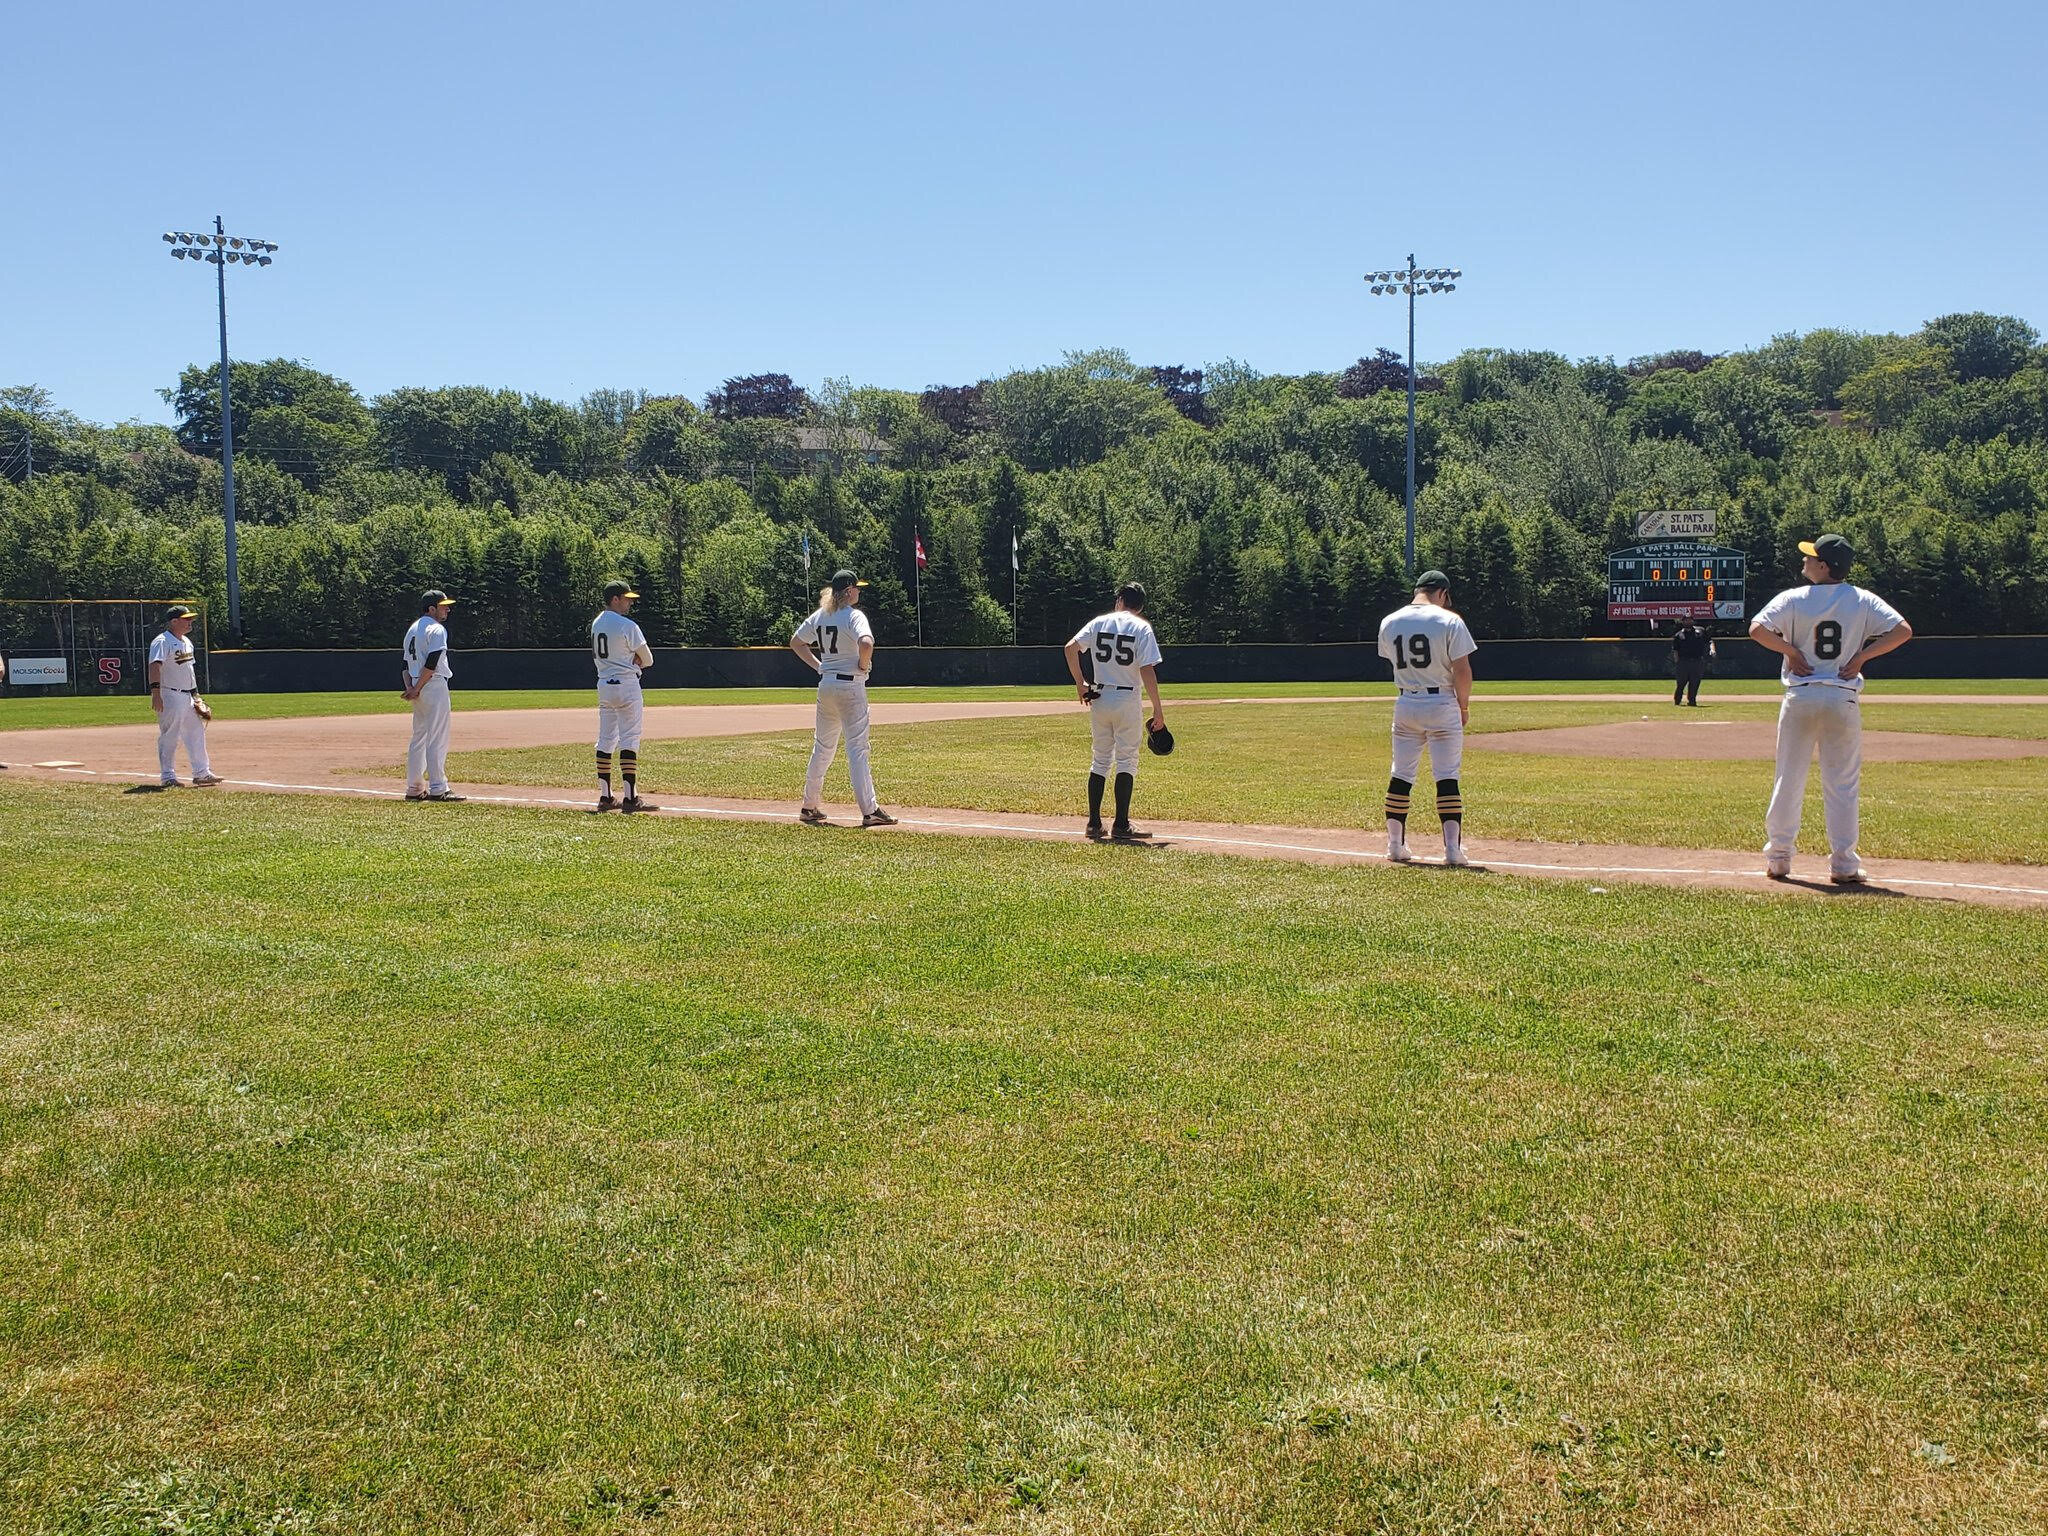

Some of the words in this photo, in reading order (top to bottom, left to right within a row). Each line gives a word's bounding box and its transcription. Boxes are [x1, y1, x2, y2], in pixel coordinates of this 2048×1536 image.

[1670, 514, 1681, 523] ST.
[1683, 513, 1704, 523] PAT'S
[1640, 513, 1664, 536] CANADIAN
[1670, 524, 1691, 533] BALL
[1692, 523, 1714, 533] PARK
[1648, 544, 1671, 552] PAT'S
[1696, 544, 1718, 553] PARK
[1650, 560, 1663, 569] BALL
[1673, 560, 1694, 569] STRIKE
[1701, 560, 1713, 568] OUT
[1652, 569, 1660, 580] 0
[1703, 569, 1711, 580] 0
[1612, 586, 1640, 595] GUESTS
[1707, 585, 1714, 594] 0
[1616, 594, 1636, 602] HOME
[1659, 607, 1668, 615] BIG
[1669, 606, 1691, 615] LEAGUES
[816, 625, 838, 654] 17
[1815, 620, 1842, 660] 8
[409, 636, 416, 660] 4
[1095, 631, 1136, 666] 55
[1393, 633, 1432, 670] 19
[98, 657, 121, 684] S
